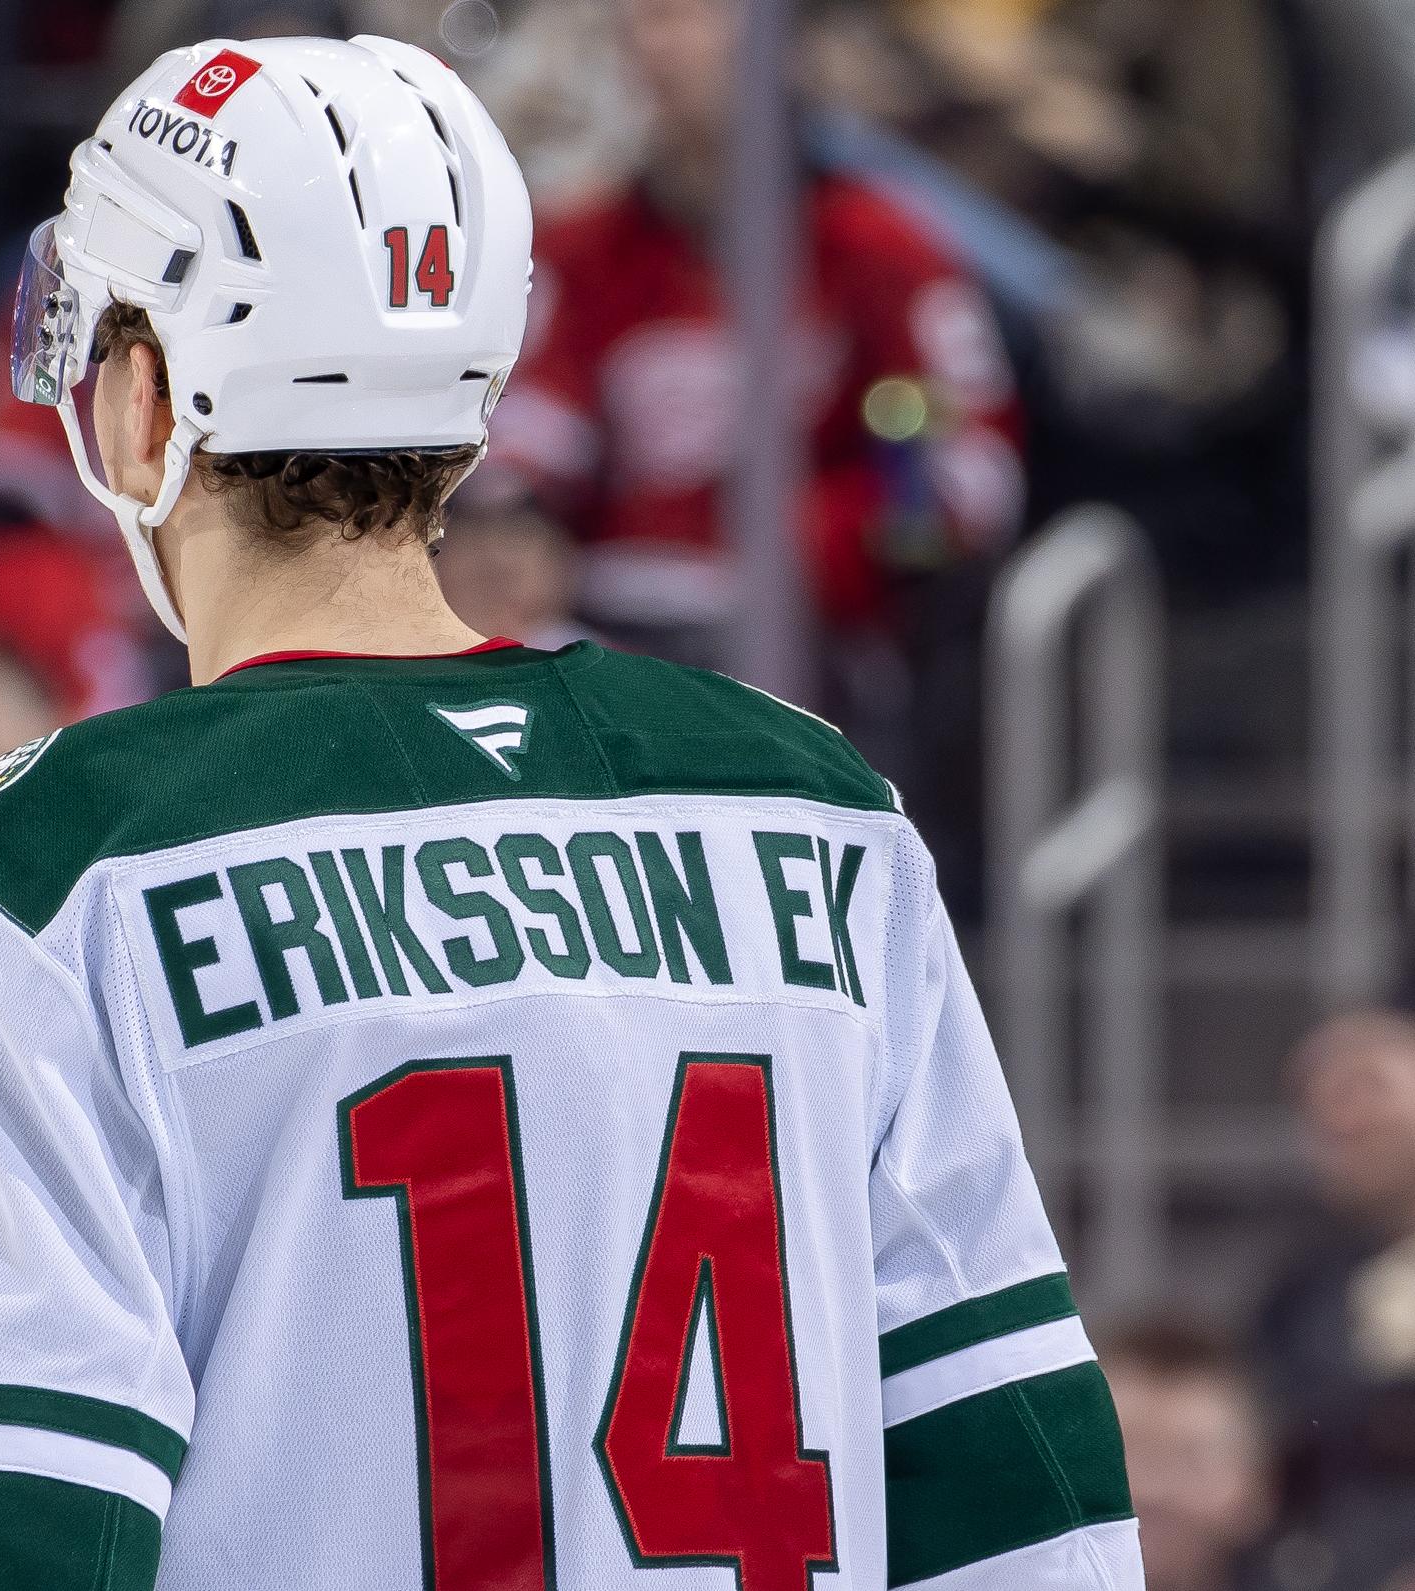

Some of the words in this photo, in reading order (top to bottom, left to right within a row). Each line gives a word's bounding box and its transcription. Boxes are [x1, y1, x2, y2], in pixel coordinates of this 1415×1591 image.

[128, 99, 238, 176] TOYOTA
[384, 225, 455, 309] 14
[141, 830, 734, 1050] ERIKSSON
[751, 830, 868, 1009] EK
[336, 1050, 840, 1591] 14
